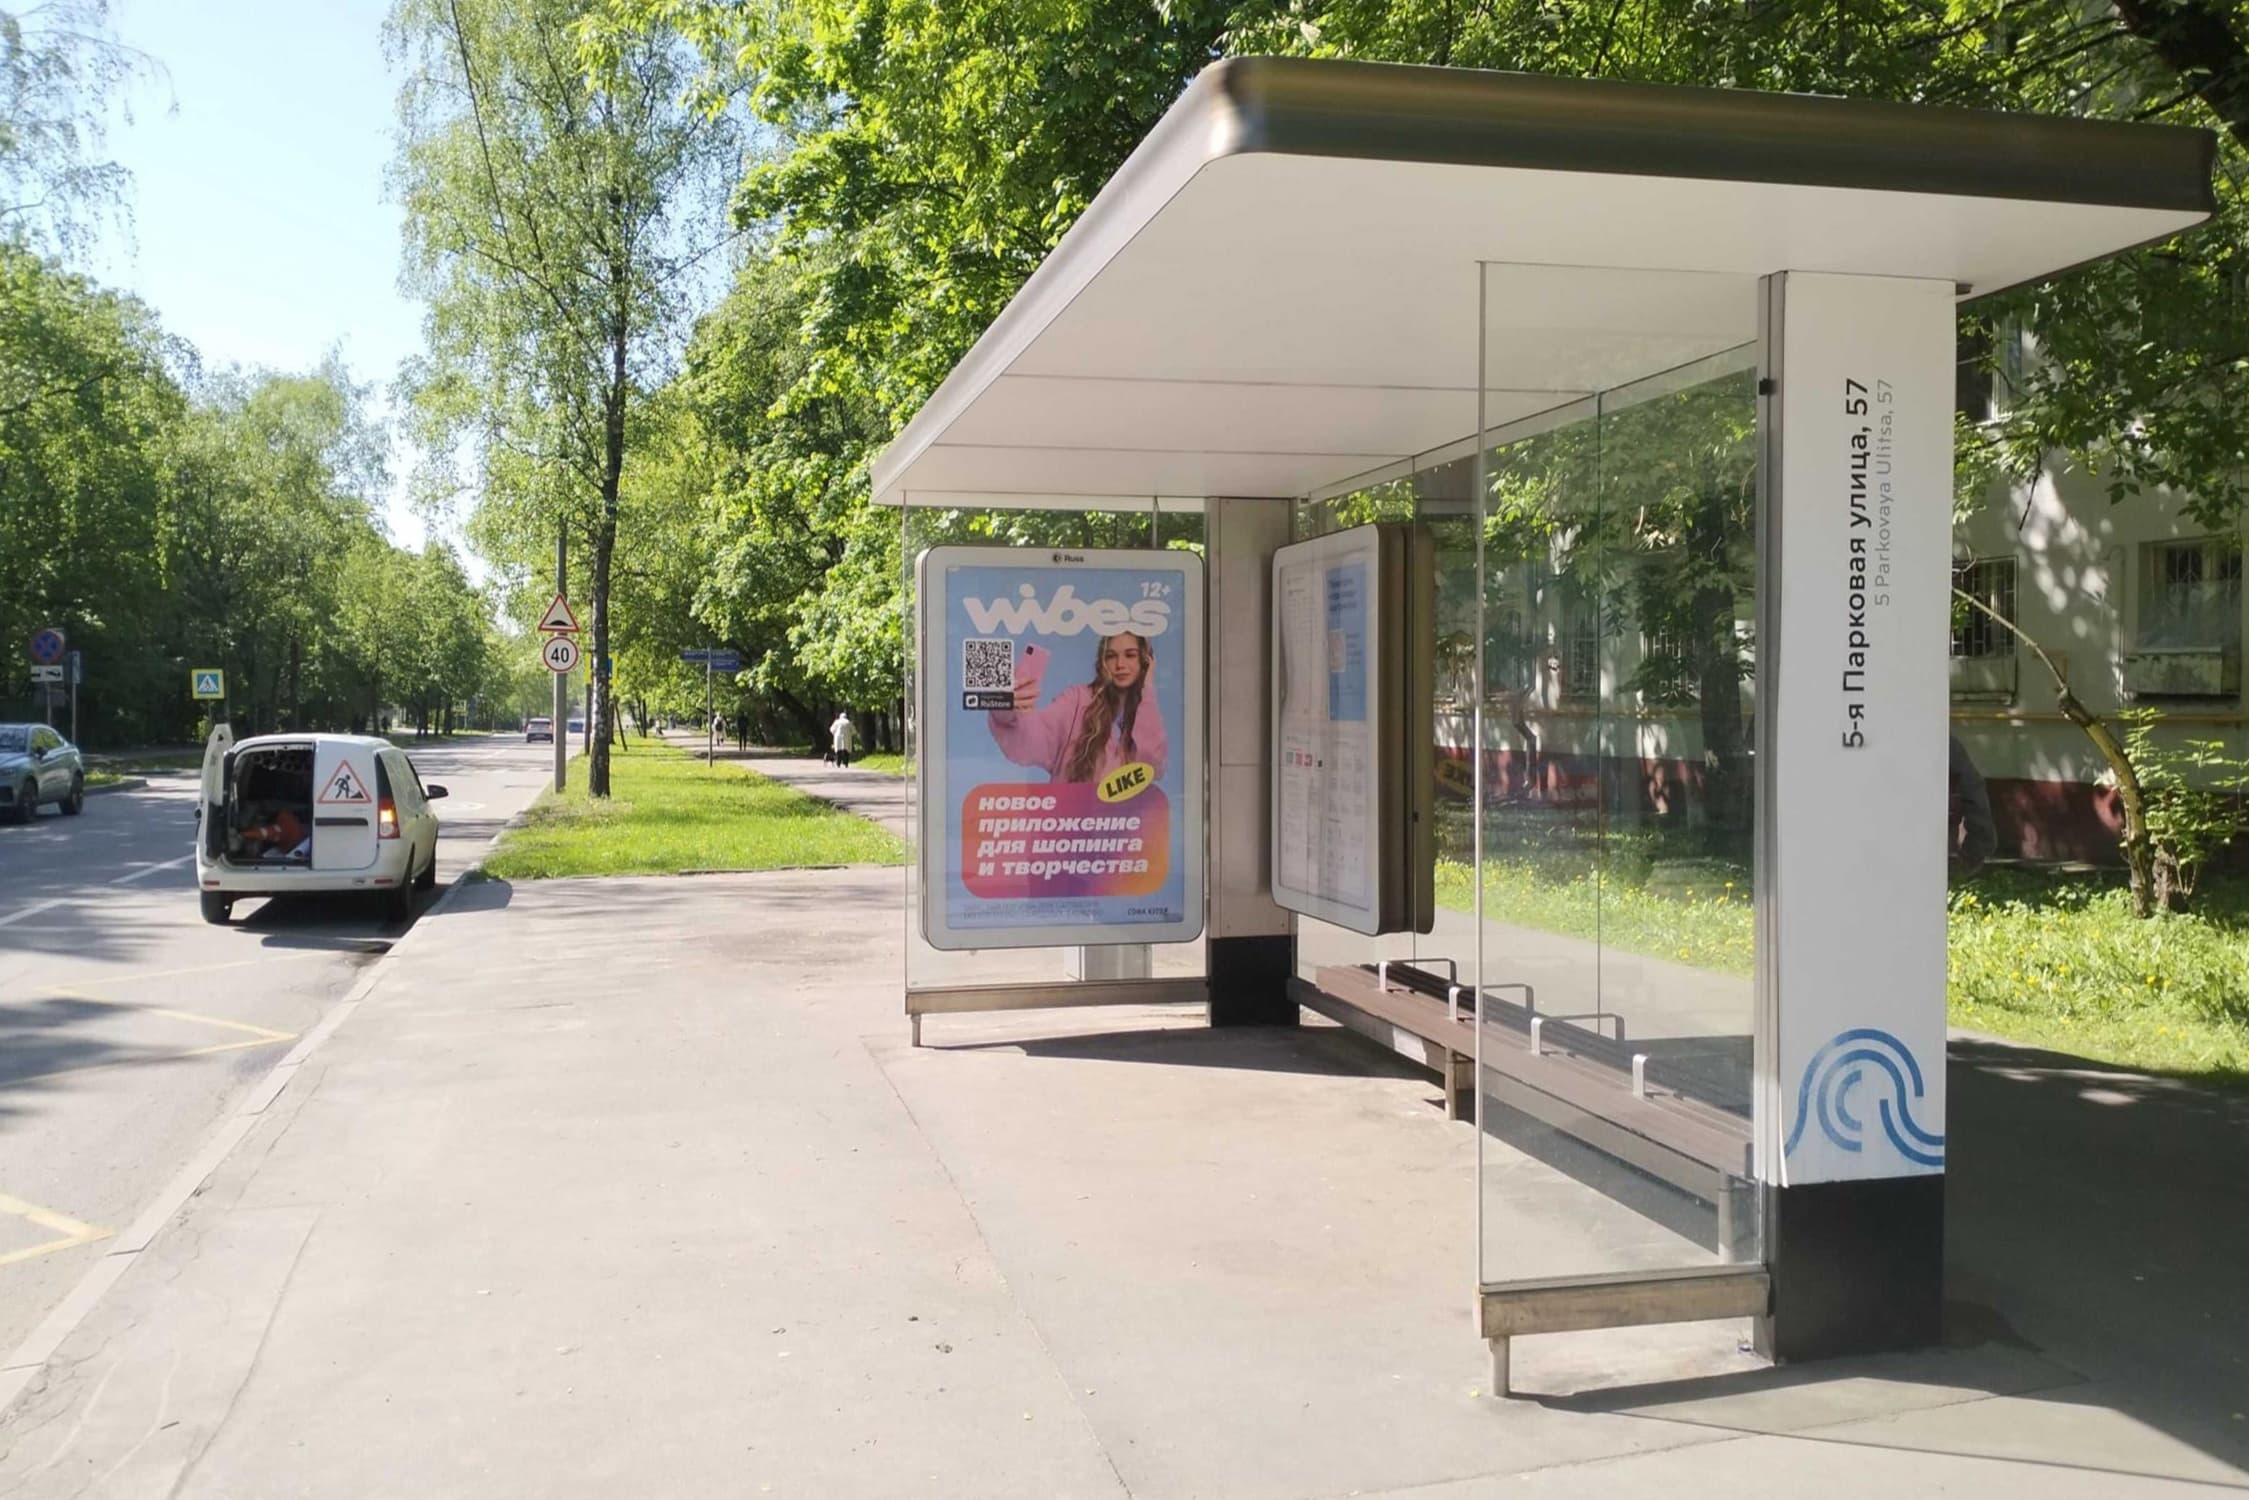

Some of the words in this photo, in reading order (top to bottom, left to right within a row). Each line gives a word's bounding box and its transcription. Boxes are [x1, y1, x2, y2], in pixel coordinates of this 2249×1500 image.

[1845, 378, 1868, 416] 57
[1876, 378, 1894, 404] 57
[1875, 410, 1894, 475] Ulitsa,
[1850, 425, 1873, 529] улица,
[1874, 481, 1895, 587] Parkovaya
[1140, 582, 1172, 598] 12+
[1874, 593, 1891, 606] 5
[1842, 538, 1871, 692] Парковая
[551, 647, 570, 663] 40
[1842, 703, 1865, 748] 5-я
[1105, 767, 1146, 798] LIKE
[978, 796, 1057, 811] новое
[978, 816, 1141, 838] приложение
[977, 840, 1027, 858] для
[1032, 837, 1144, 854] шопинга
[978, 861, 996, 876] и
[1002, 858, 1148, 880] творчества
